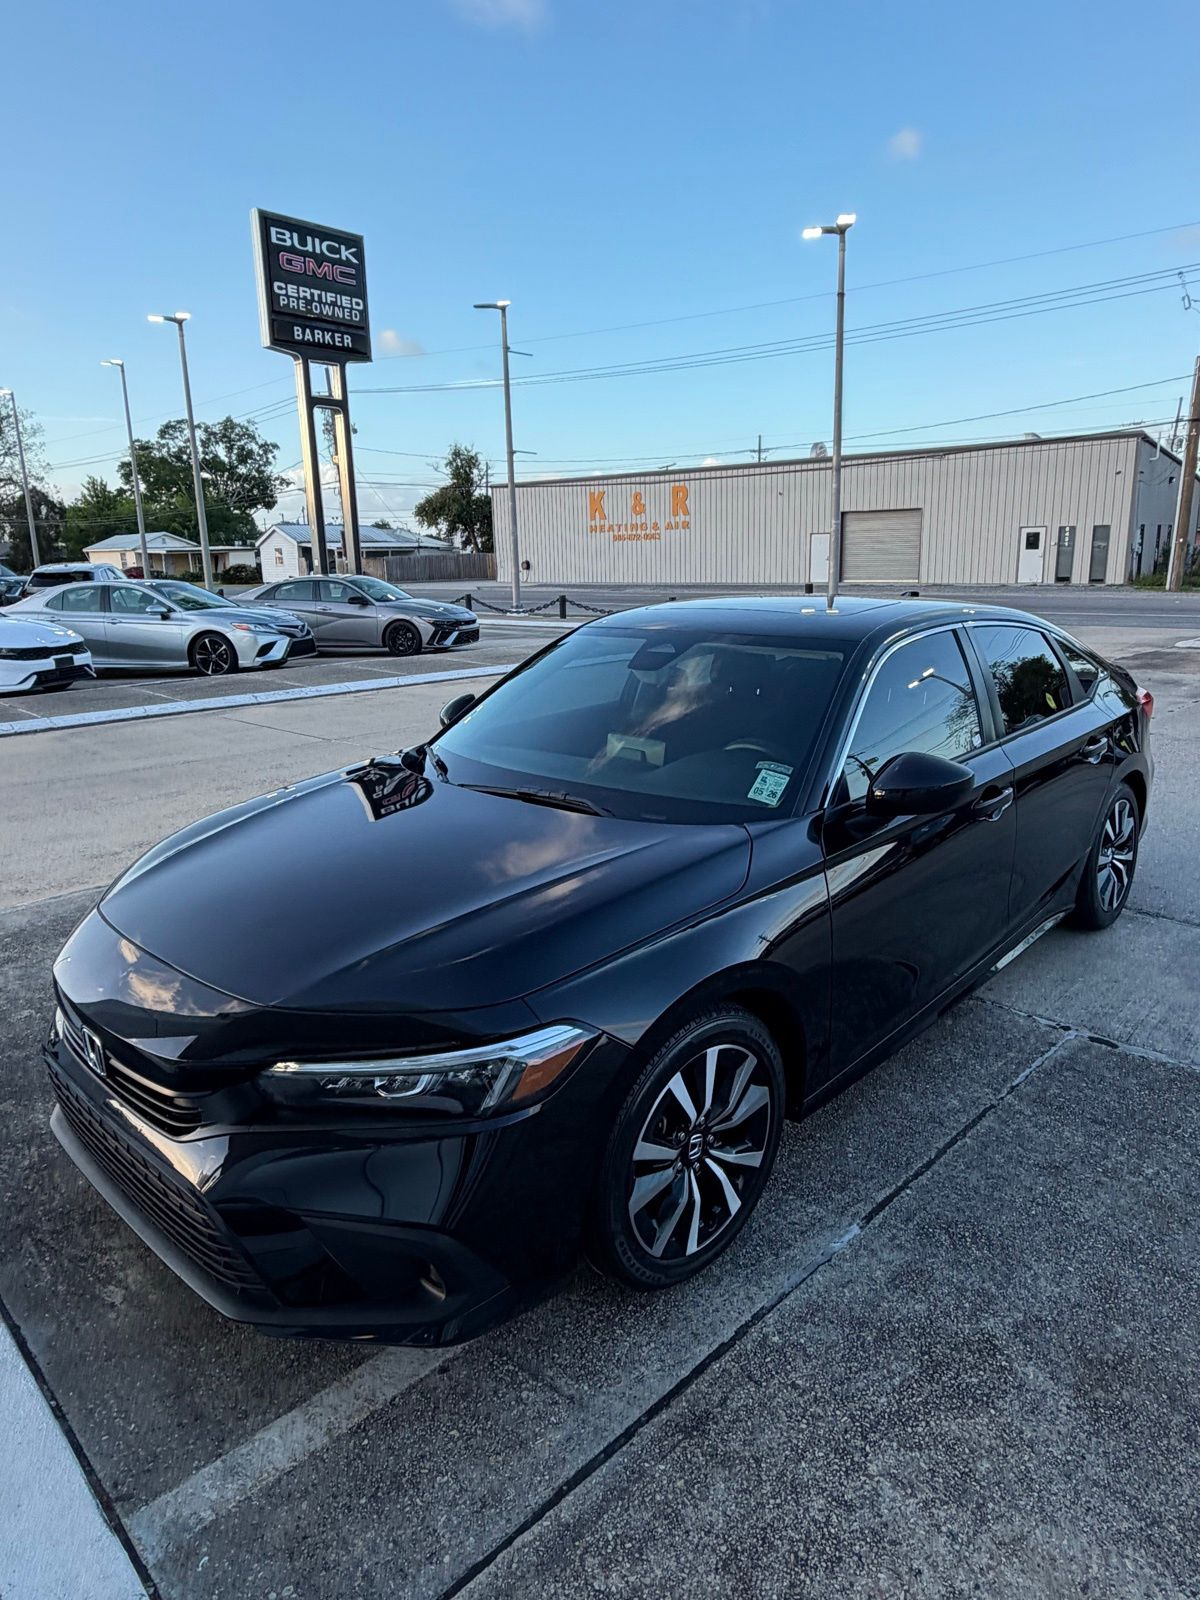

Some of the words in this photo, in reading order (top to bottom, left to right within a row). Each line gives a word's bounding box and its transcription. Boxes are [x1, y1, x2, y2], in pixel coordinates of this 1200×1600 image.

[270, 226, 359, 264] BUICK
[279, 251, 357, 285] GMC
[273, 281, 364, 310] CERTIFIED
[280, 296, 360, 321] PRE-OWNED
[293, 326, 352, 347] BARKER
[589, 490, 607, 521] K
[632, 491, 646, 516] &
[672, 485, 690, 517] R
[589, 522, 648, 534] HEATING
[652, 521, 660, 531] &
[664, 520, 690, 530] AIR
[753, 787, 765, 795] 05
[766, 790, 778, 799] 26
